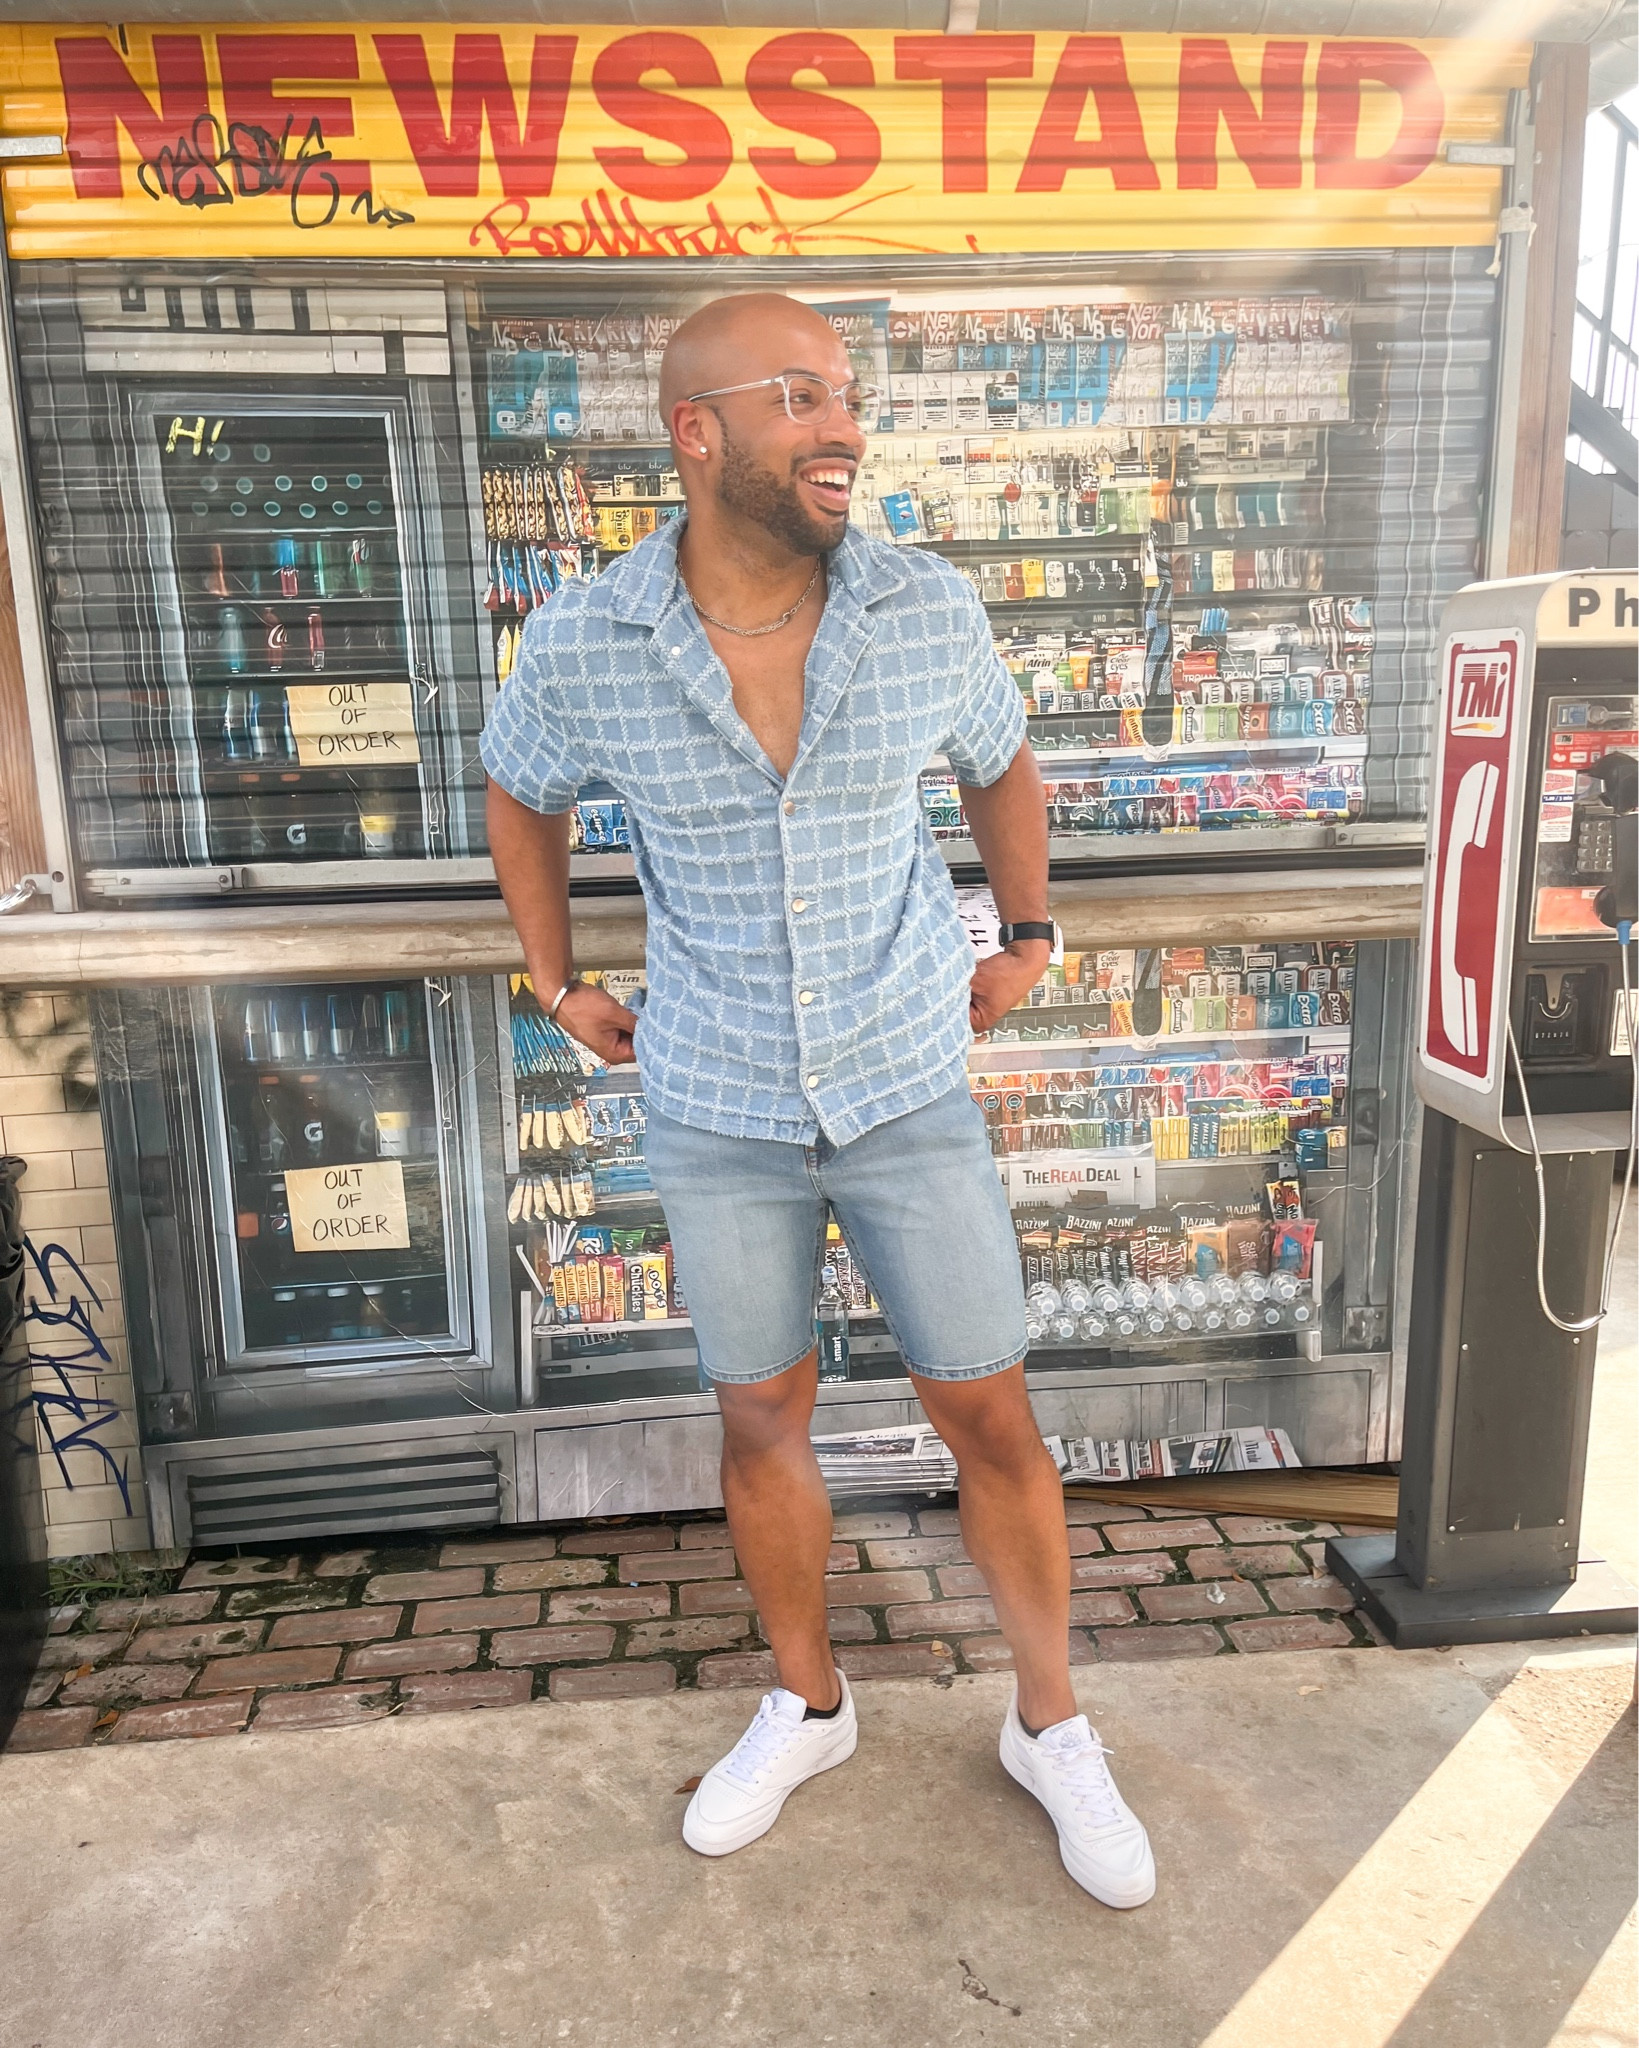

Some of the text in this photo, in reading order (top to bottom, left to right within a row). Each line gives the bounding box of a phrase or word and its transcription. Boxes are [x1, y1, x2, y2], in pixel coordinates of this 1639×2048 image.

[55, 30, 1446, 200] NEWSSTAND
[1027, 658, 1051, 668] Afrin
[1110, 656, 1130, 664] Clear
[328, 684, 368, 706] OUT
[341, 708, 367, 724] OF
[1312, 702, 1326, 736] Extra
[1343, 701, 1357, 734] Extra
[318, 731, 402, 755] ORDER
[286, 823, 307, 844] G
[1100, 954, 1120, 962] Clear
[1297, 994, 1312, 1025] Extra
[1327, 993, 1343, 1023] Extra
[304, 1121, 323, 1141] G
[324, 1169, 363, 1189] OUT
[337, 1193, 362, 1209] OF
[313, 1215, 391, 1241] ORDER
[1066, 1215, 1101, 1231] BAZZINI
[631, 1265, 644, 1313] Chuckles
[834, 1335, 842, 1363] smart
